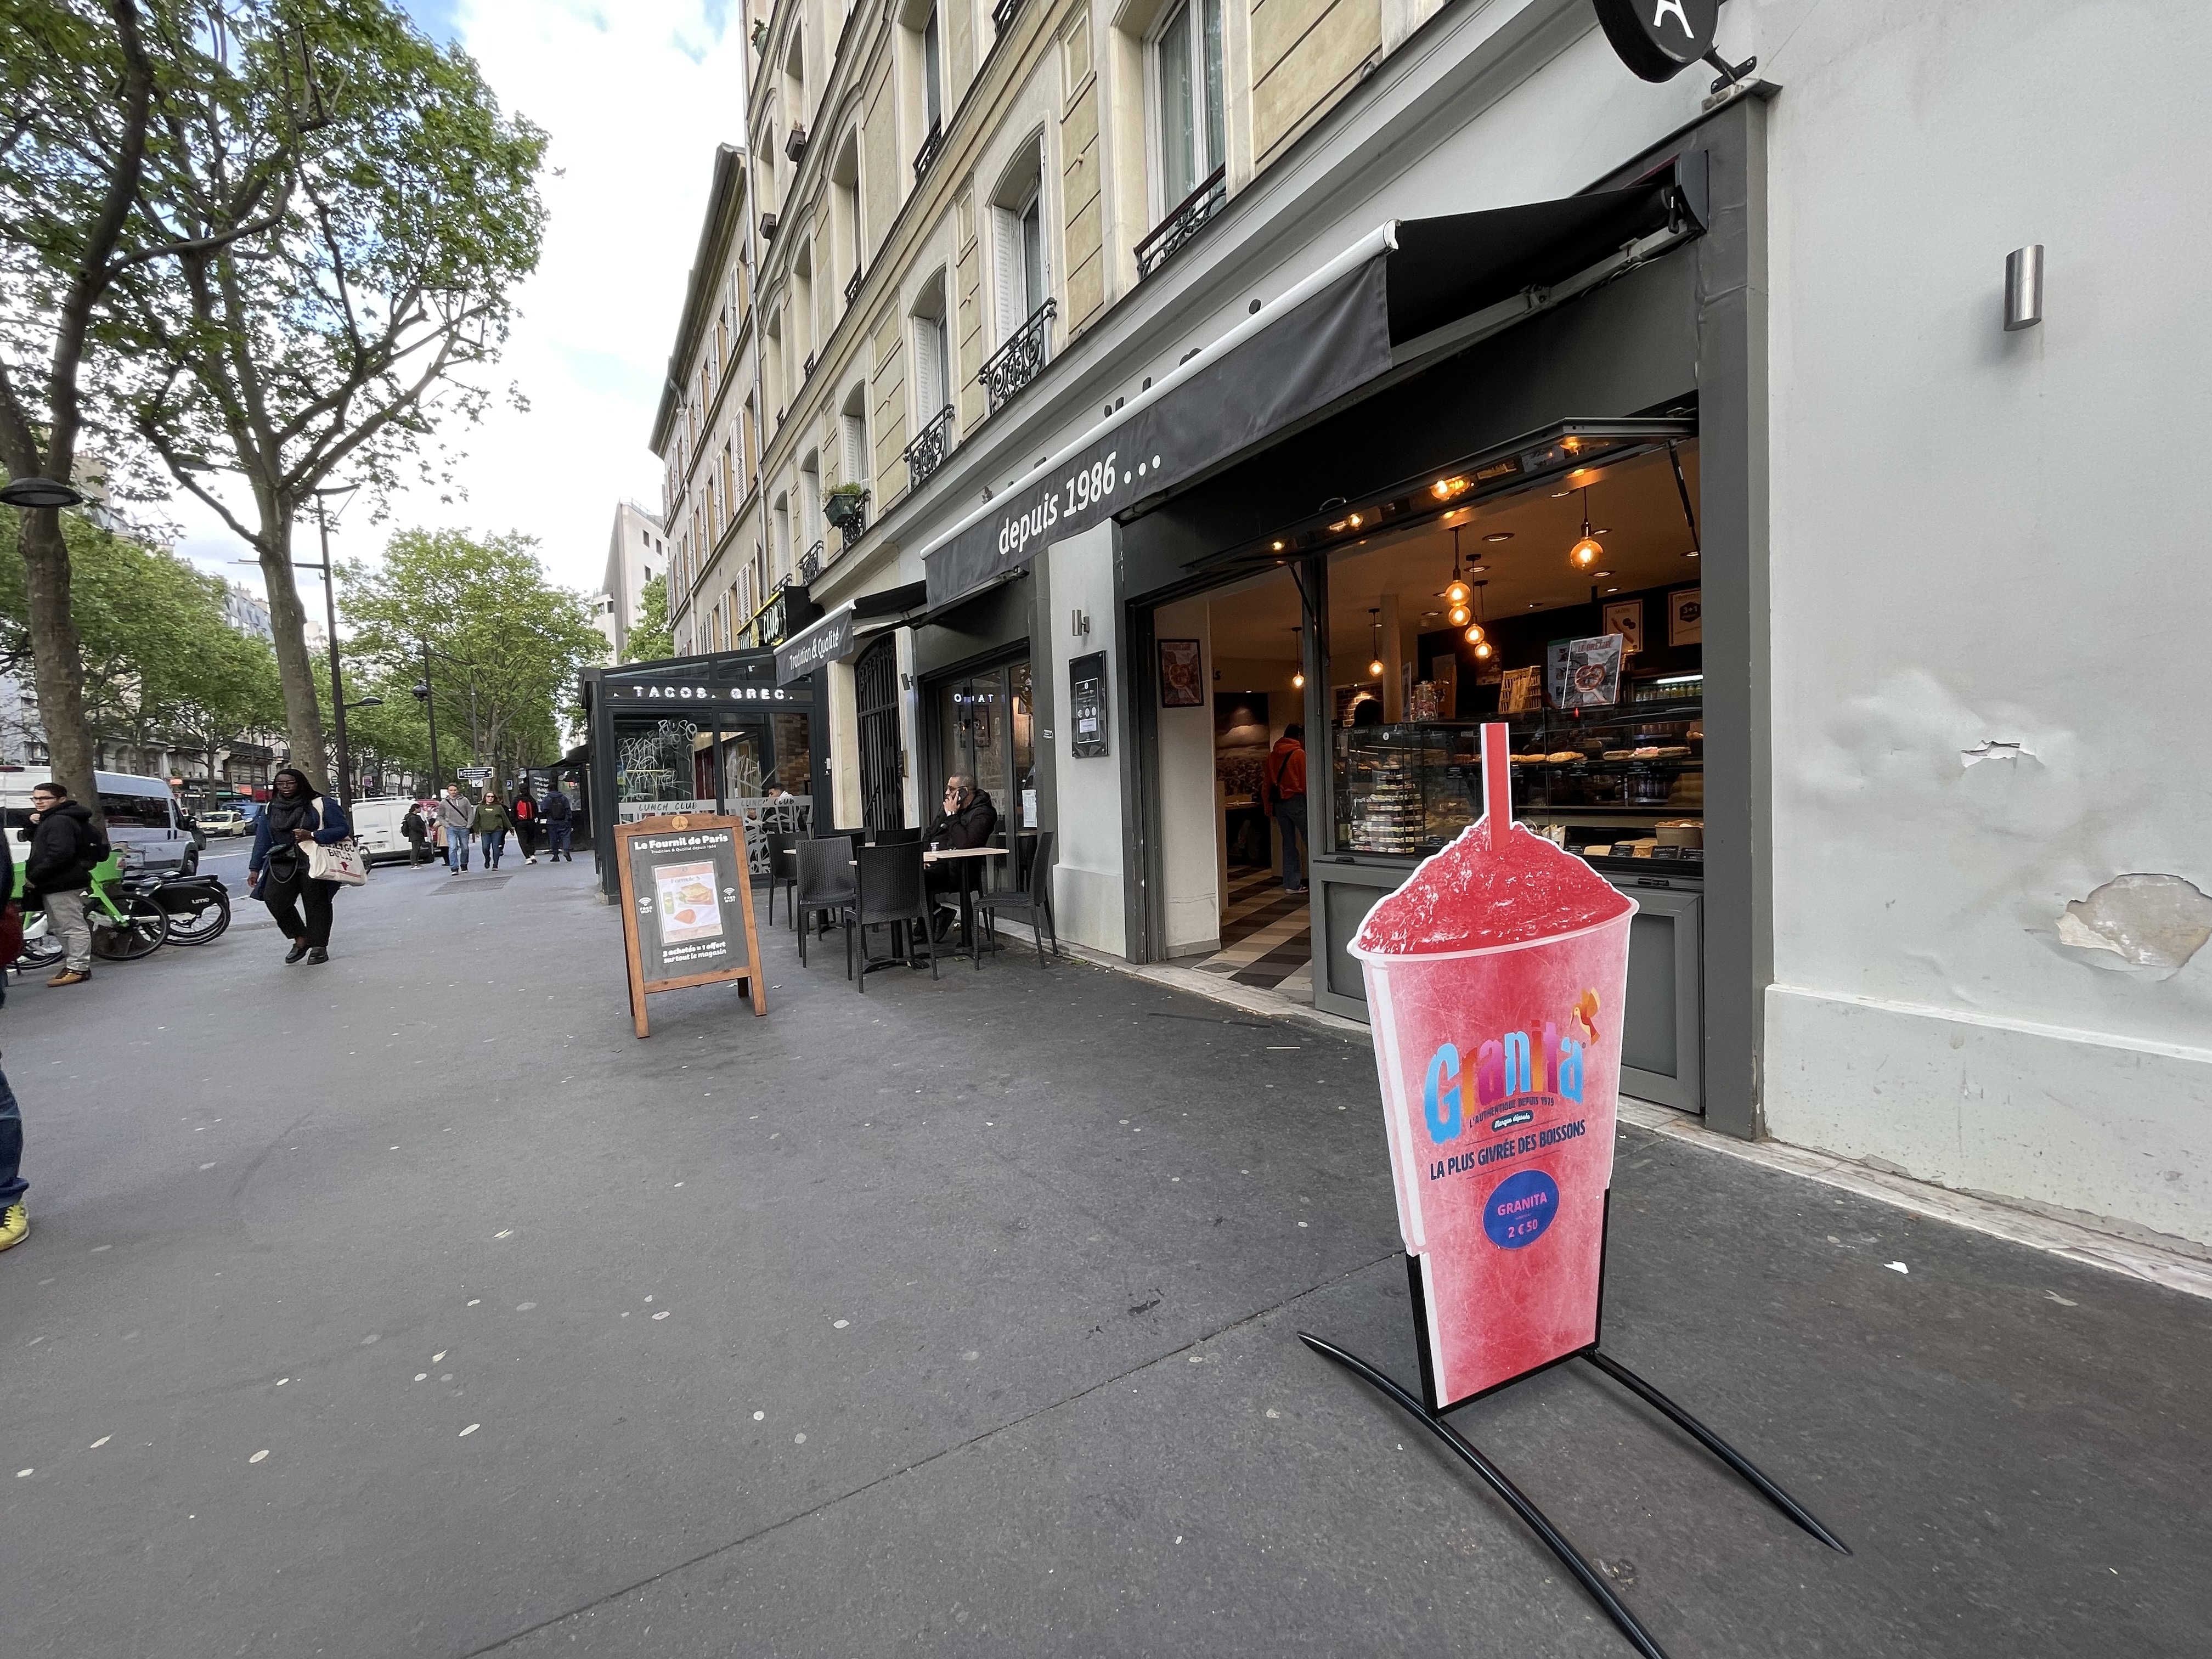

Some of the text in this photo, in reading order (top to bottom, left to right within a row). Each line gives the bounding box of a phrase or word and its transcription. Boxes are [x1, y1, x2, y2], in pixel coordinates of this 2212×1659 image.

[999, 492, 1059, 555] depuis
[1063, 452, 1116, 517] 1986
[789, 627, 839, 670] Tradition & Qualité
[639, 802, 697, 811] LUNCH CLUB
[634, 833, 729, 850] Le Fournil de Paris
[668, 945, 696, 956] achetés
[706, 941, 726, 950] offert
[675, 953, 690, 962] tout
[698, 948, 727, 958] magasin
[1425, 1020, 1585, 1144] Granita
[1469, 1099, 1516, 1128] L'AUTHENTIQUE
[1518, 1097, 1538, 1107] DEPUIS
[1430, 1119, 1586, 1181] LA PLUS GIVRÉE DES BOISSONS
[1498, 1192, 1548, 1216] GRANITA
[1508, 1227, 1515, 1238] 2
[1527, 1219, 1538, 1233] 50
